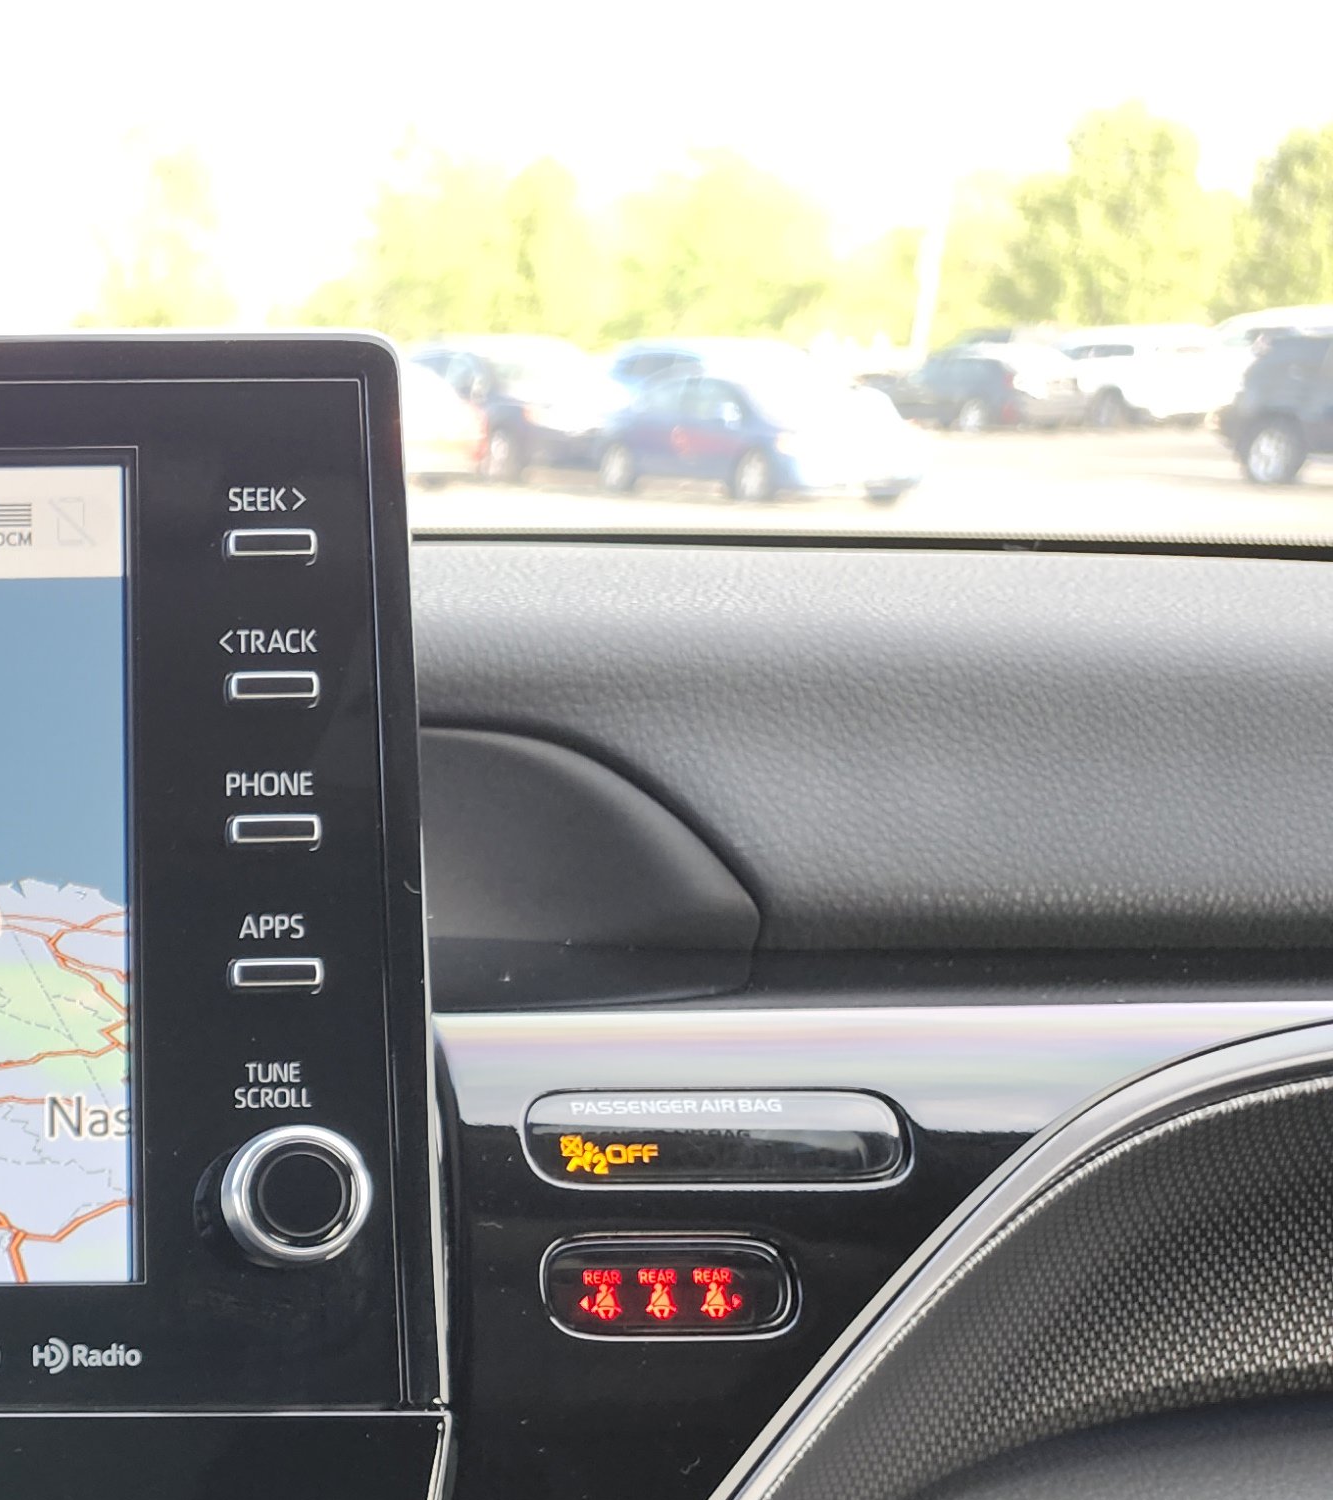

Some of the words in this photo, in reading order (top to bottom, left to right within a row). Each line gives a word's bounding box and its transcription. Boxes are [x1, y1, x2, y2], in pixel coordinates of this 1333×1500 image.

[225, 772, 314, 797] PHONE
[238, 914, 305, 940] APPS
[244, 1062, 302, 1084] TUNE
[233, 1086, 312, 1110] SCROLL
[570, 1099, 698, 1116] PASSENGER
[700, 1098, 737, 1115] AIR
[739, 1097, 783, 1114] BAG
[604, 1142, 660, 1166] OFF
[583, 1268, 622, 1285] REAR
[638, 1268, 677, 1284] REAR
[693, 1267, 732, 1284] REAR
[72, 1344, 143, 1368] Radio
